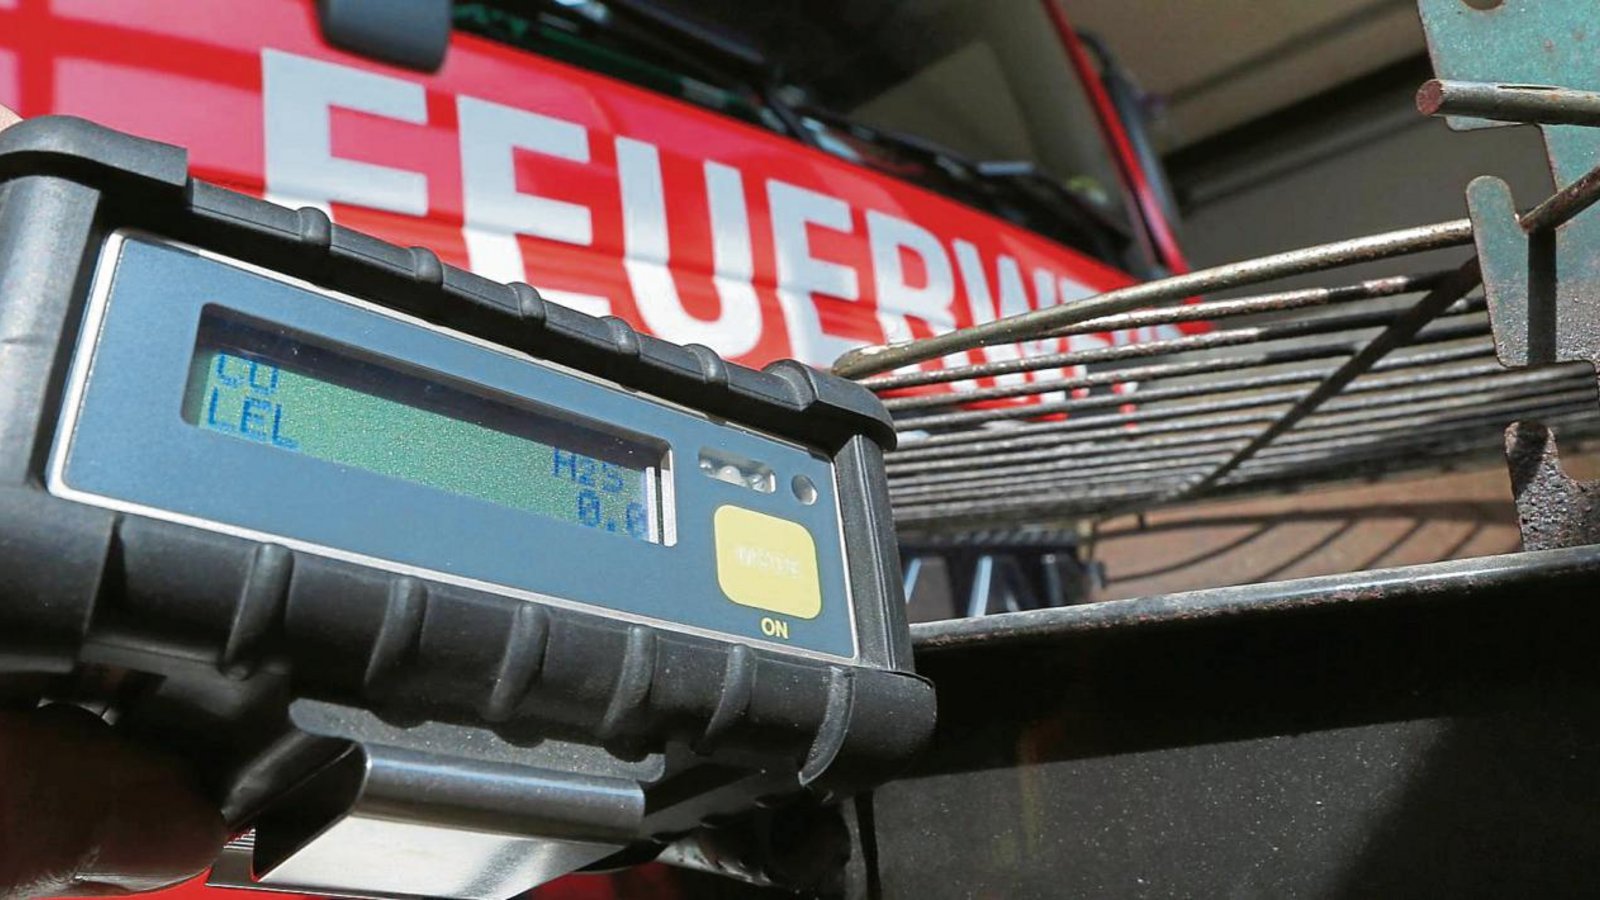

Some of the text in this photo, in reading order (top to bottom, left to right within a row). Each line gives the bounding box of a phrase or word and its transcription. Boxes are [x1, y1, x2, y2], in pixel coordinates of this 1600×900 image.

[208, 386, 300, 449] LEL
[551, 446, 624, 493] H2S
[760, 616, 789, 639] ON
